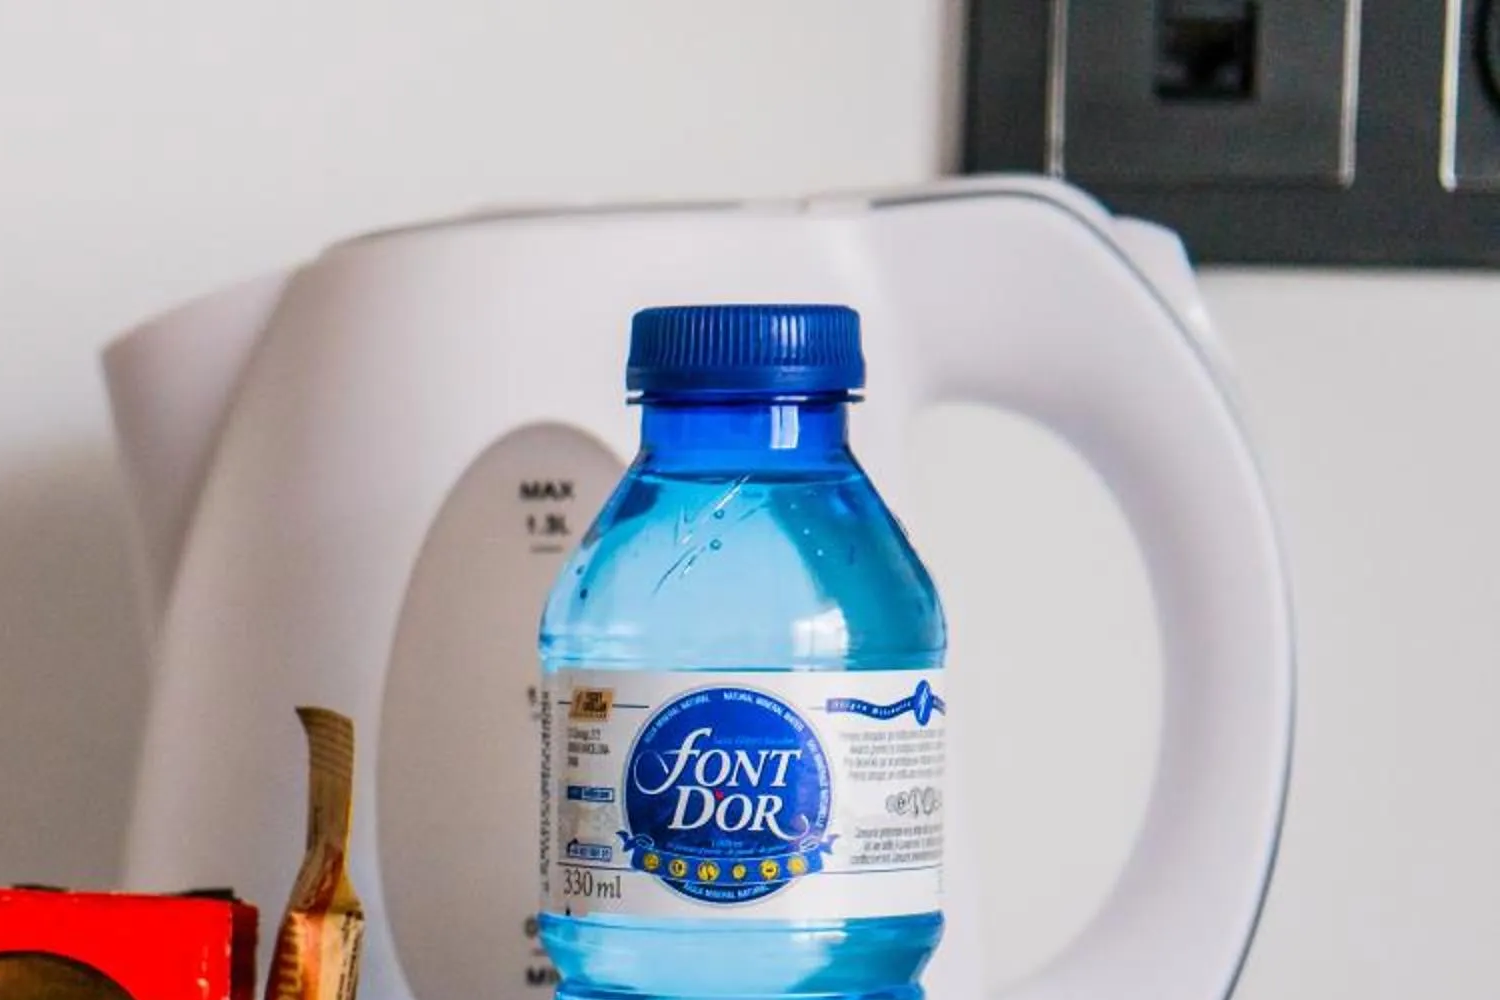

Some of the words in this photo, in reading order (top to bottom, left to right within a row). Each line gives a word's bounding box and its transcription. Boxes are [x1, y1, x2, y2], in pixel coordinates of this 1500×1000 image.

[519, 479, 575, 501] MAX
[563, 868, 593, 897] 330
[596, 875, 622, 899] ml
